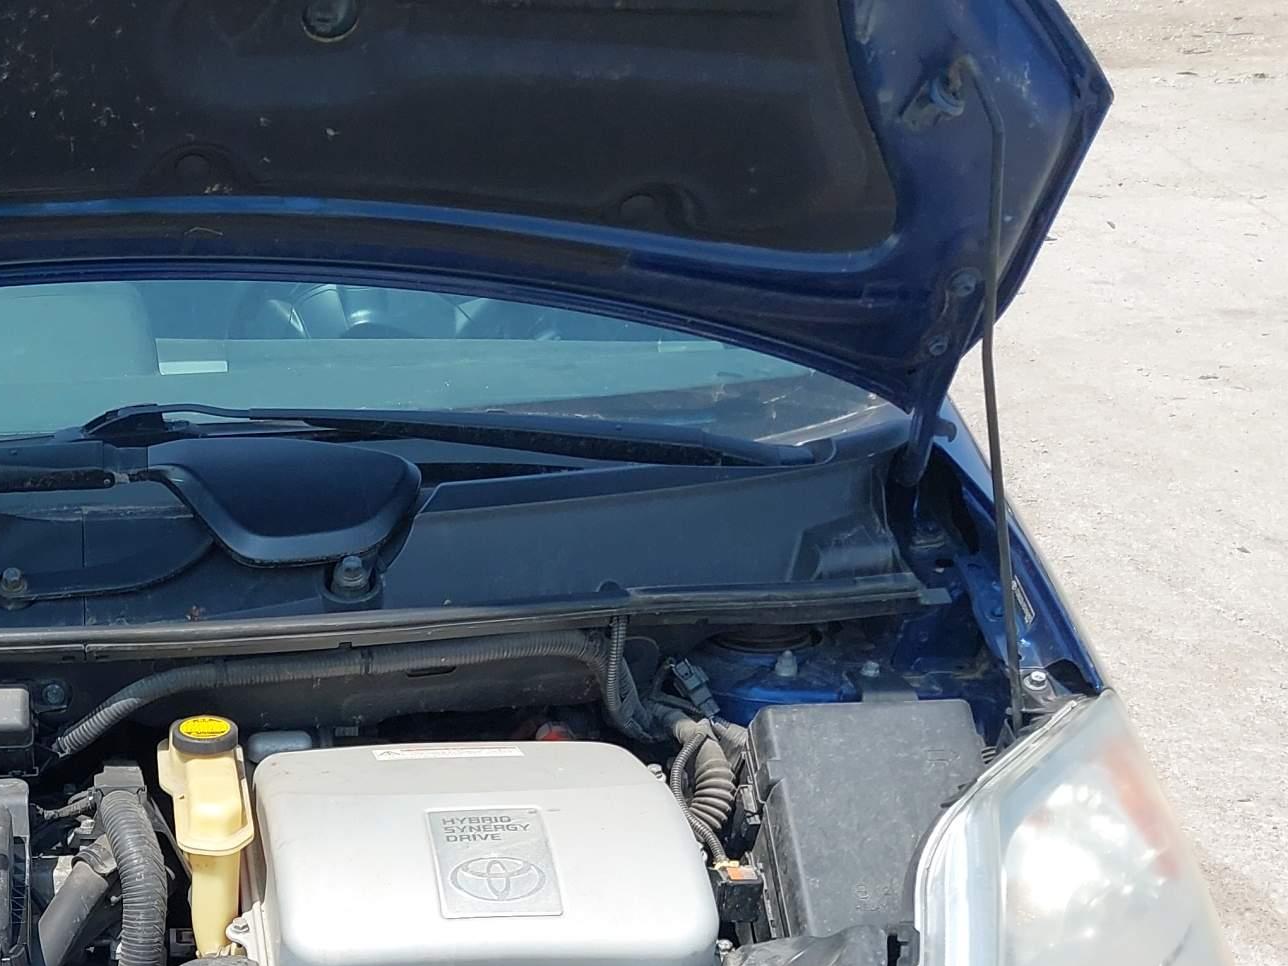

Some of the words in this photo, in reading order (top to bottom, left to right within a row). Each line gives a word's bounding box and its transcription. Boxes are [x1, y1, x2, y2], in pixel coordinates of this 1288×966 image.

[441, 815, 512, 825] HYBRID
[443, 823, 530, 834] SYNERGY
[445, 833, 502, 842] DRIVE
